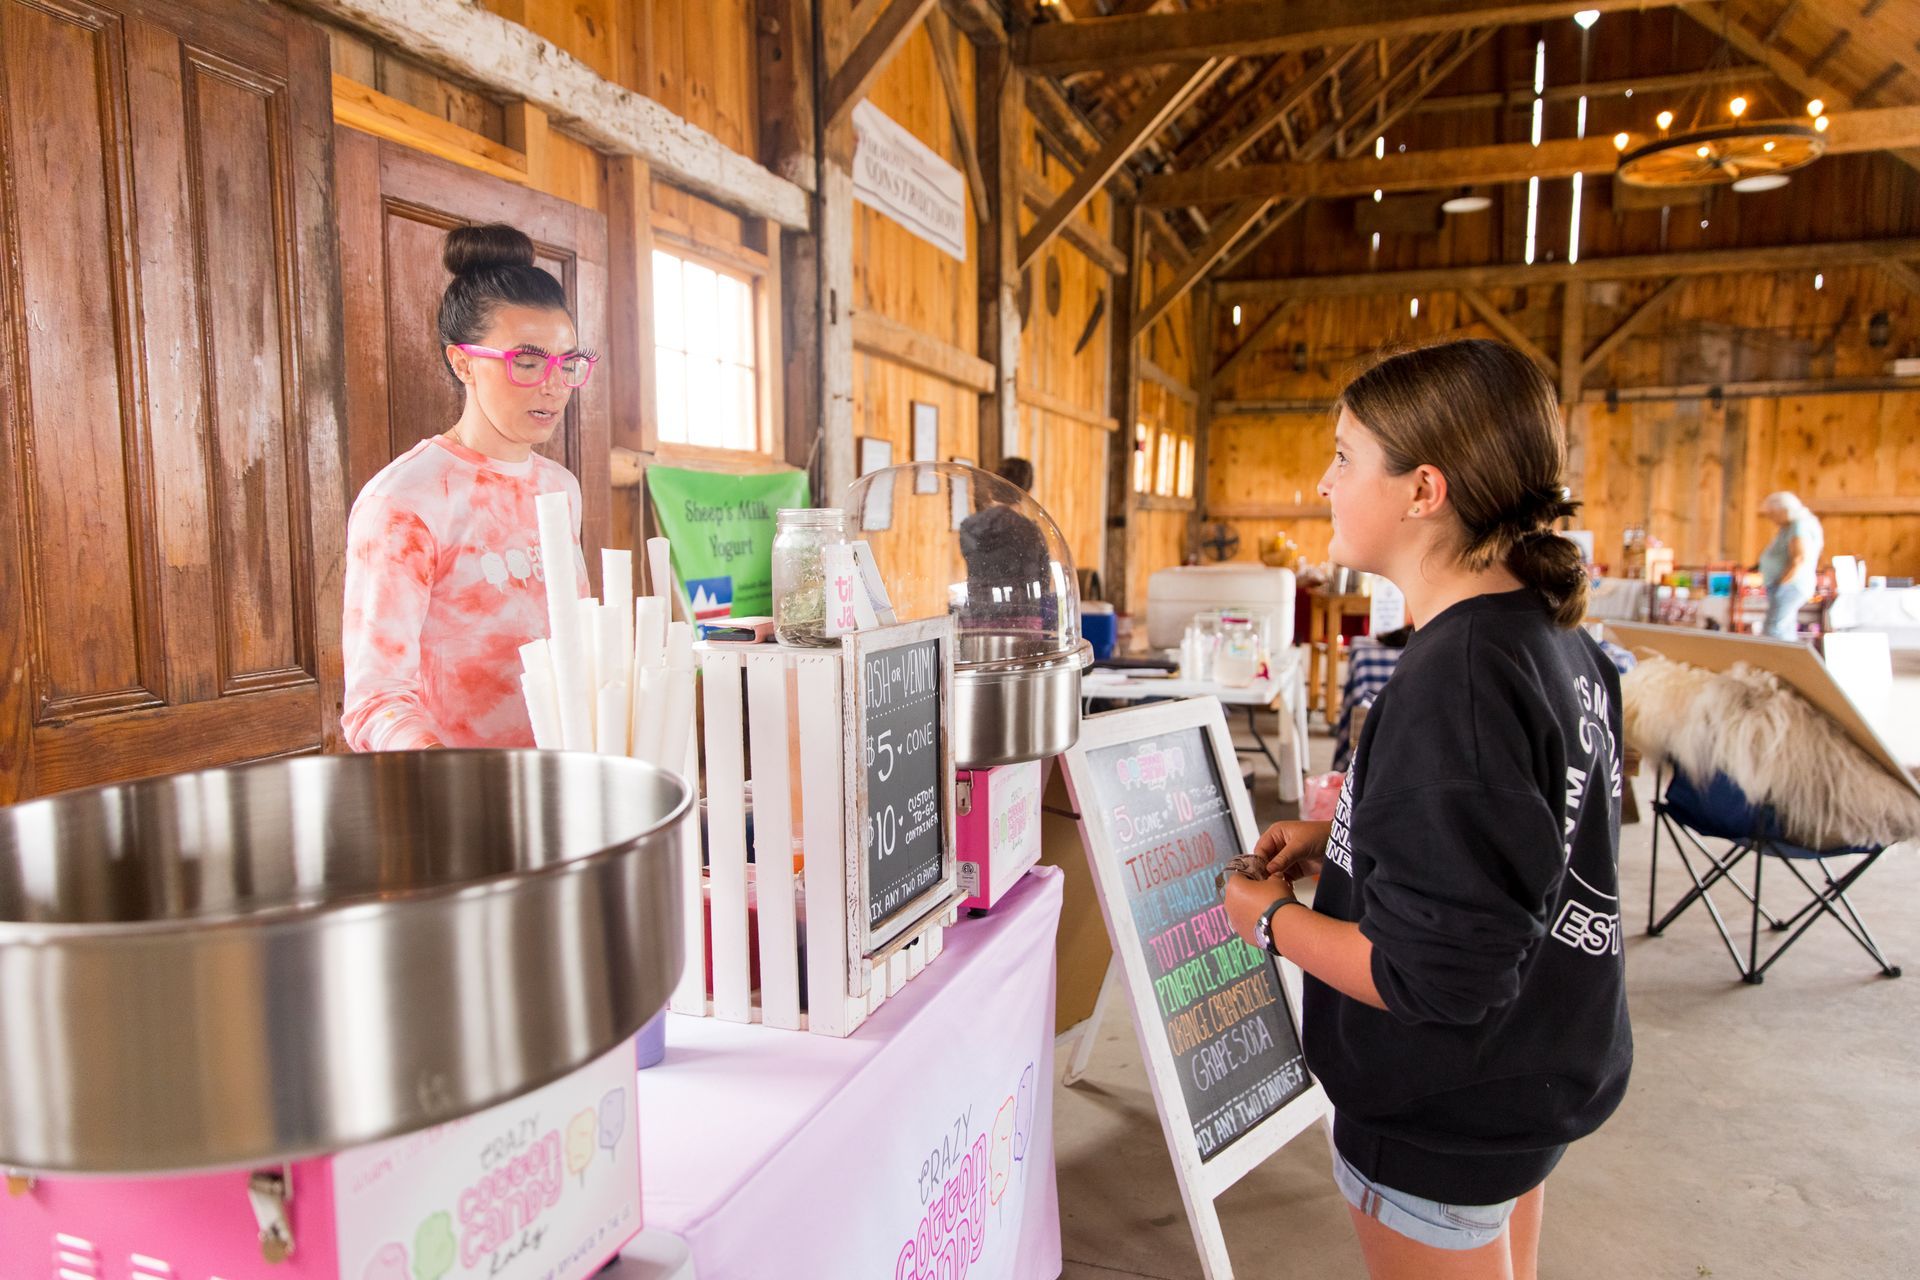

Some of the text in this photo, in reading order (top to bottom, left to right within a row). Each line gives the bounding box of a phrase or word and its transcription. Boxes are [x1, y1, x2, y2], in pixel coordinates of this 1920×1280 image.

[685, 499, 770, 528] Sheep's Milk
[708, 535, 754, 563] Yogurt
[866, 646, 938, 710] ASH OR VENMO
[906, 722, 933, 756] CONE
[907, 785, 935, 812] CUSTOM
[912, 801, 935, 824] TO-GO
[1134, 811, 1165, 837] CONE
[905, 813, 939, 845] CONTAINER
[884, 889, 900, 912] ANY
[901, 877, 916, 899] TWO
[916, 860, 941, 887] FLAVORS
[1125, 831, 1216, 893] TIGERS BLOOD
[1163, 864, 1223, 920] HAWAII
[1149, 922, 1196, 973] TUTTI
[1155, 954, 1217, 1017] PINEAPPLE
[1167, 969, 1277, 1058] ORANGE CREAMSICKLE
[1191, 1015, 1274, 1092] GRAPE SODA
[1194, 1068, 1298, 1156] MIX ANY TWO FLAVORS
[479, 1112, 541, 1170] CRAZY
[917, 1103, 973, 1206] CRAZY
